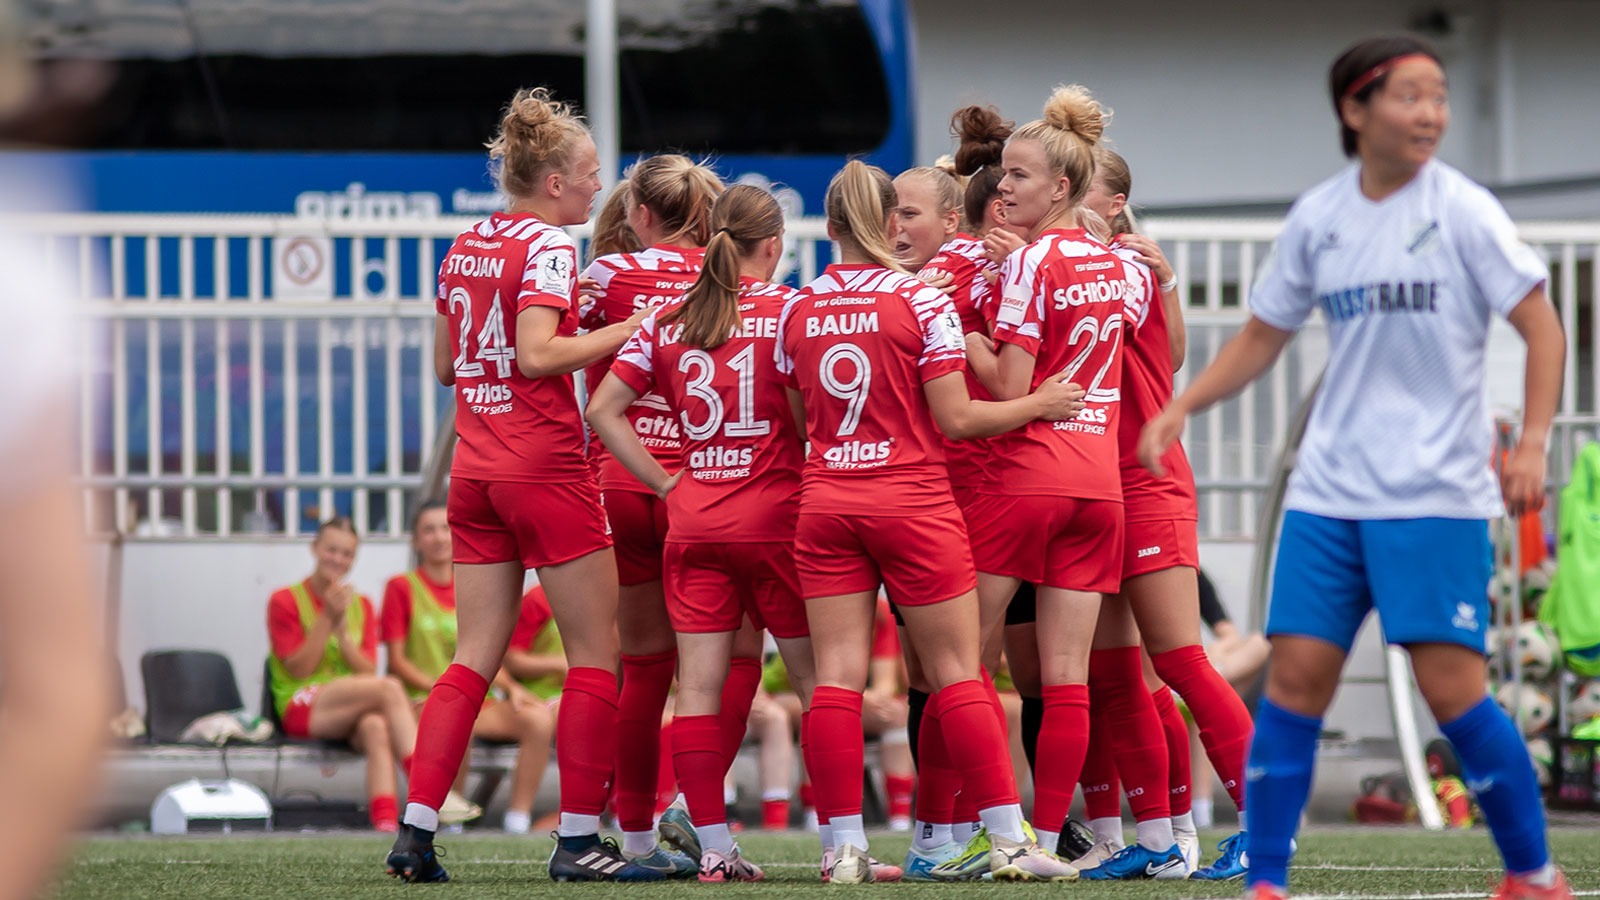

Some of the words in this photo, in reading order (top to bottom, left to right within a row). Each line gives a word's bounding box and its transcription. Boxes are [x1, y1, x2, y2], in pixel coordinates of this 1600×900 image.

[447, 254, 505, 278] STOJAN
[655, 281, 673, 290] FSV
[448, 286, 517, 379] 24
[805, 312, 880, 338] BAUM
[1062, 313, 1122, 402] 22
[676, 342, 771, 441] 31
[818, 342, 872, 437] 9
[1053, 421, 1084, 433] SAFETY
[689, 446, 754, 469] atlas
[823, 440, 891, 463] atlas
[692, 469, 722, 480] SAFETY
[721, 467, 751, 479] SHOES
[1137, 545, 1161, 558] JAKO
